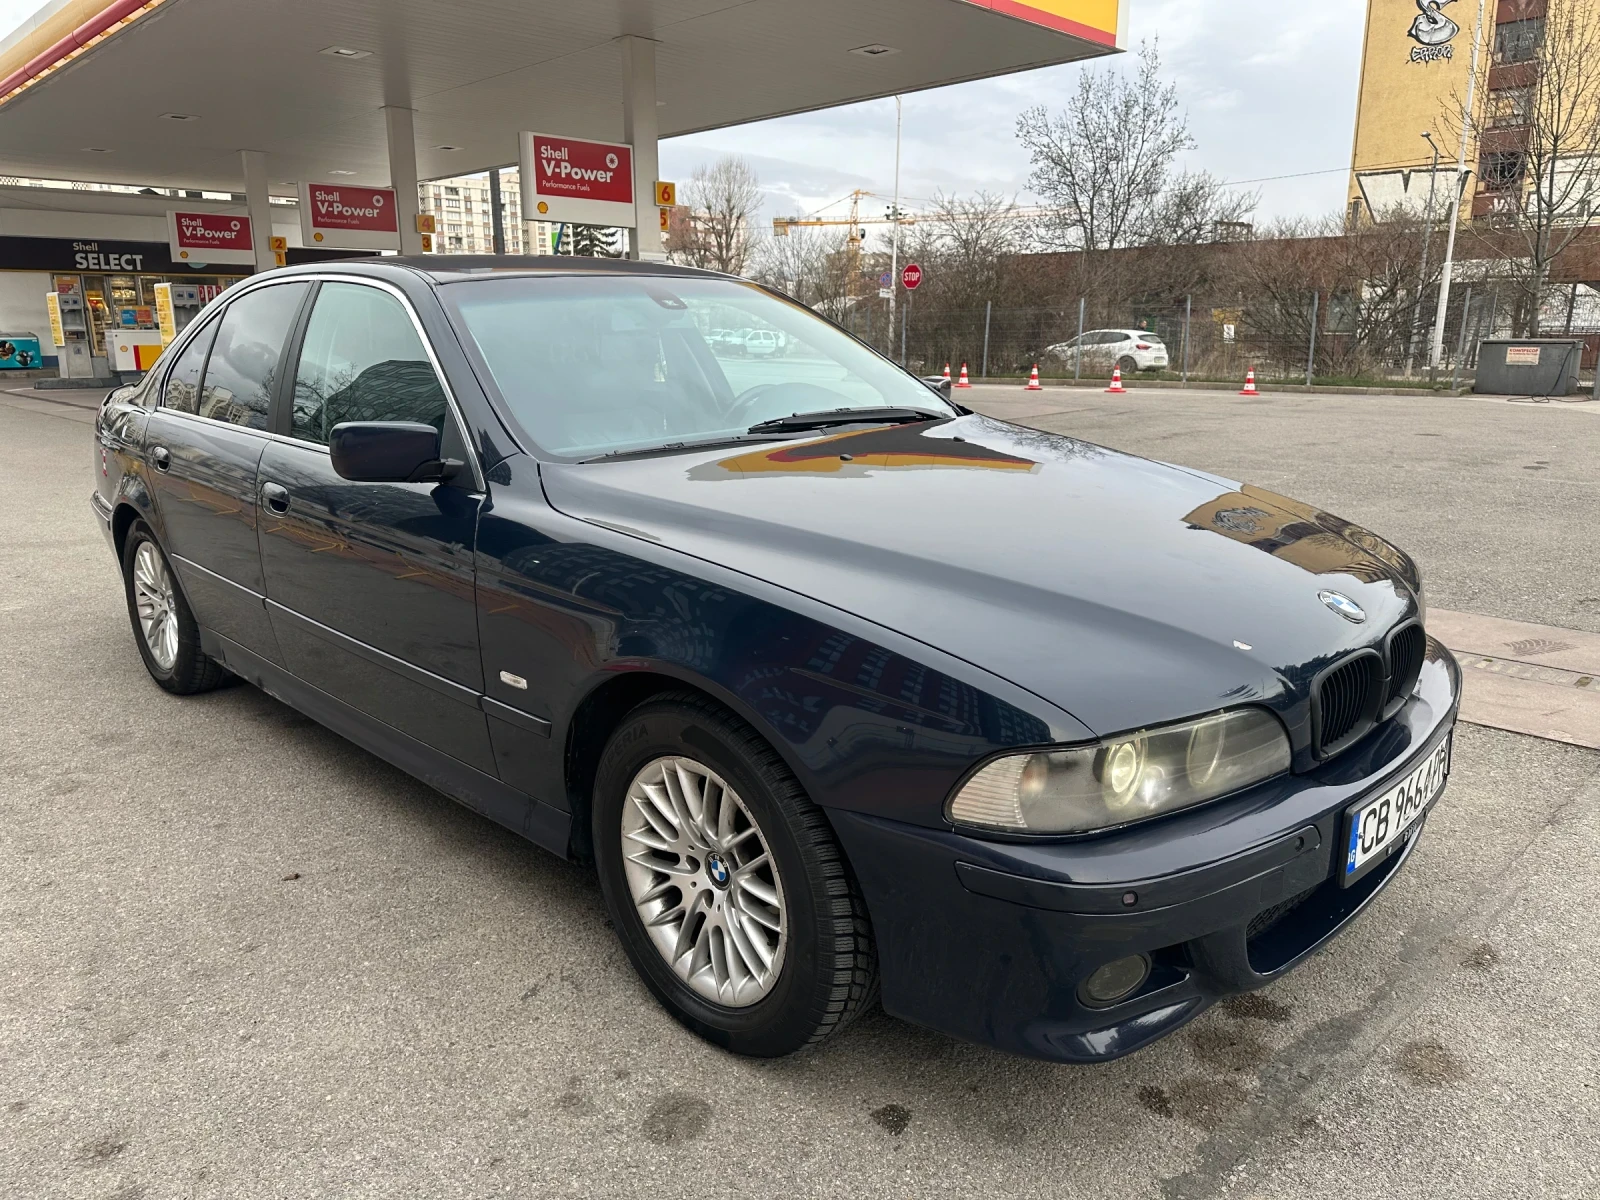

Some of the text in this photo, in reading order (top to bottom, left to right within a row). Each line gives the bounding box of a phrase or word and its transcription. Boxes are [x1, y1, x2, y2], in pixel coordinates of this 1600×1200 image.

[540, 145, 568, 160] Shell
[542, 159, 613, 182] V-Power
[542, 180, 590, 192] Performance Fuels
[315, 191, 339, 201] Shell
[661, 186, 671, 202] 6
[317, 202, 379, 217] V-Power
[181, 217, 202, 227] Shell
[317, 216, 347, 224] Performance
[421, 218, 431, 230] 4
[660, 212, 667, 226] 5
[182, 226, 237, 239] V-Power
[72, 242, 98, 251] Shell
[275, 238, 283, 249] 2
[422, 236, 430, 249] 3
[75, 252, 143, 271] SELECT
[277, 253, 283, 263] 1
[904, 272, 920, 281] STOP
[1361, 799, 1390, 854] CB
